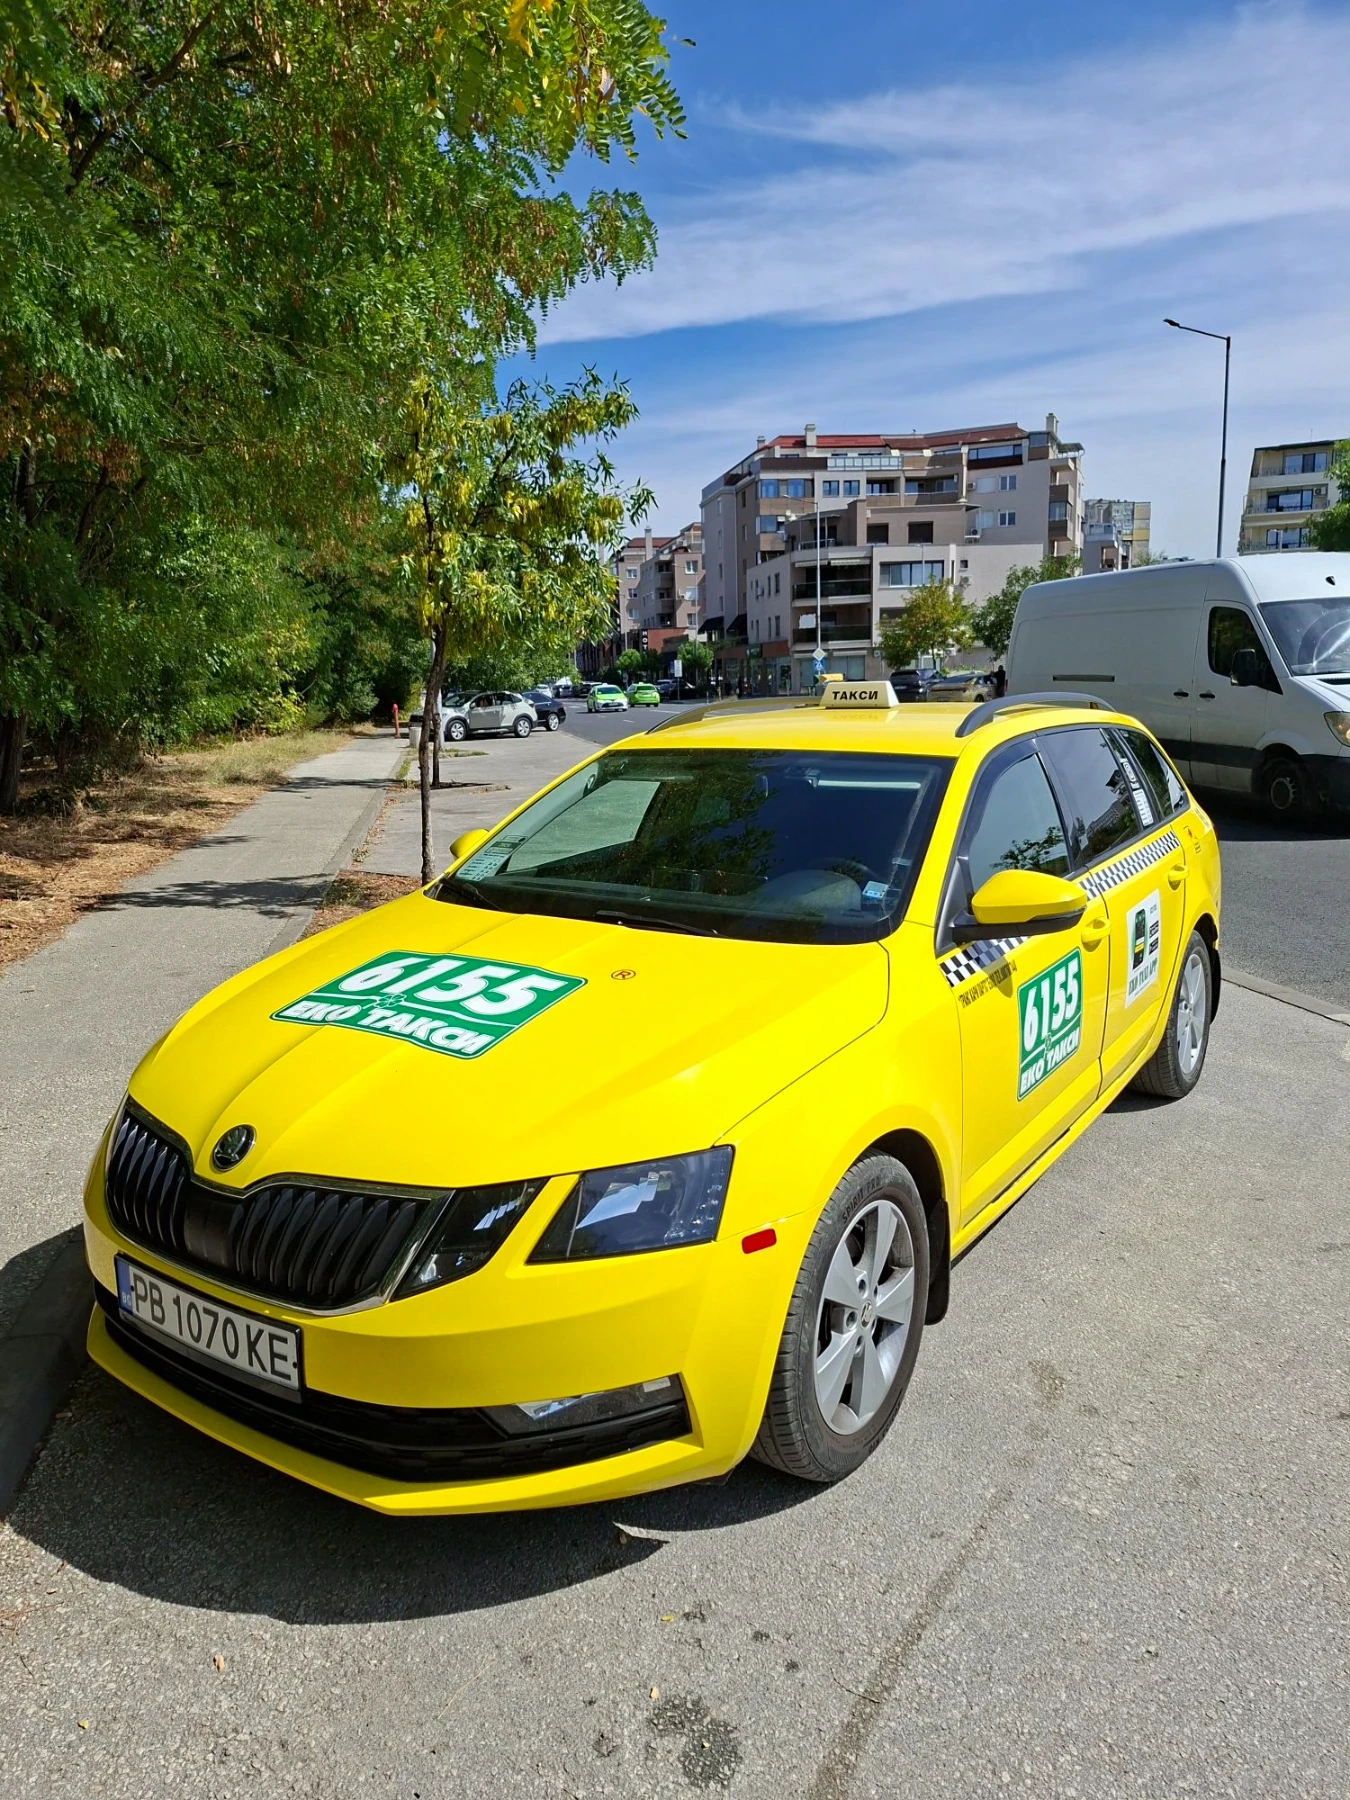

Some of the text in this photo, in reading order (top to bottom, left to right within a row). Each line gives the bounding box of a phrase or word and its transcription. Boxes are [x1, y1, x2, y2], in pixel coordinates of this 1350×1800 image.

[832, 690, 879, 701] ТАКСИ
[338, 956, 568, 1016] 6155
[1023, 956, 1079, 1052] 6155
[284, 999, 495, 1054] ЕКО ТАКСИ
[1020, 1026, 1080, 1096] ЕКО ТАКСИ
[842, 1176, 880, 1225] SPIRIT PRO
[121, 1290, 133, 1307] BG
